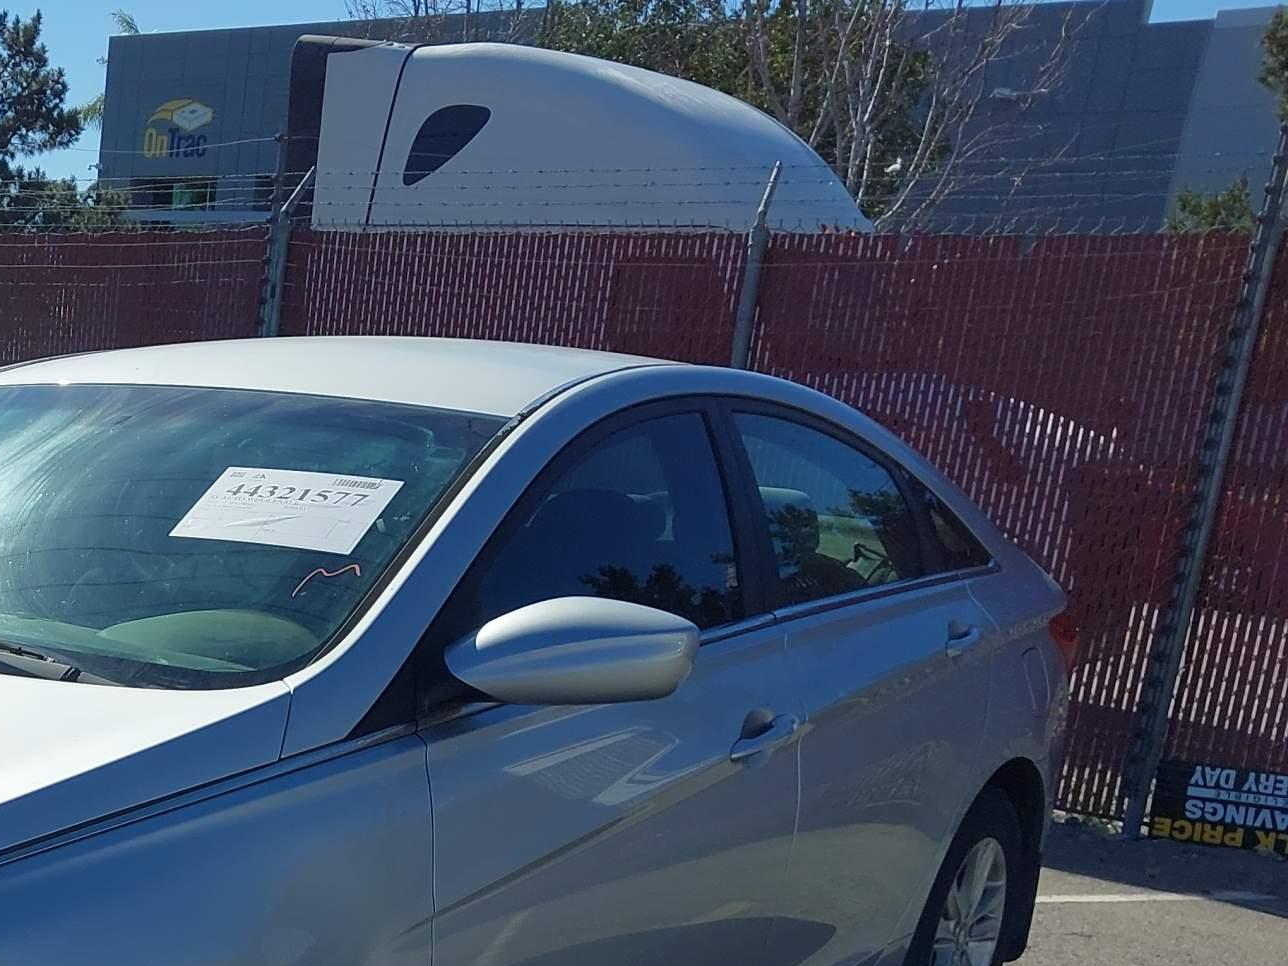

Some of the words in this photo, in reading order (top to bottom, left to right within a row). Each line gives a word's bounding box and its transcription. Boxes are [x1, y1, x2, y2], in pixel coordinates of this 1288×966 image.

[143, 127, 207, 159] OnTrac
[226, 483, 369, 507] 44321577
[1189, 765, 1237, 790] DAY
[1151, 816, 1245, 848] PRICE
